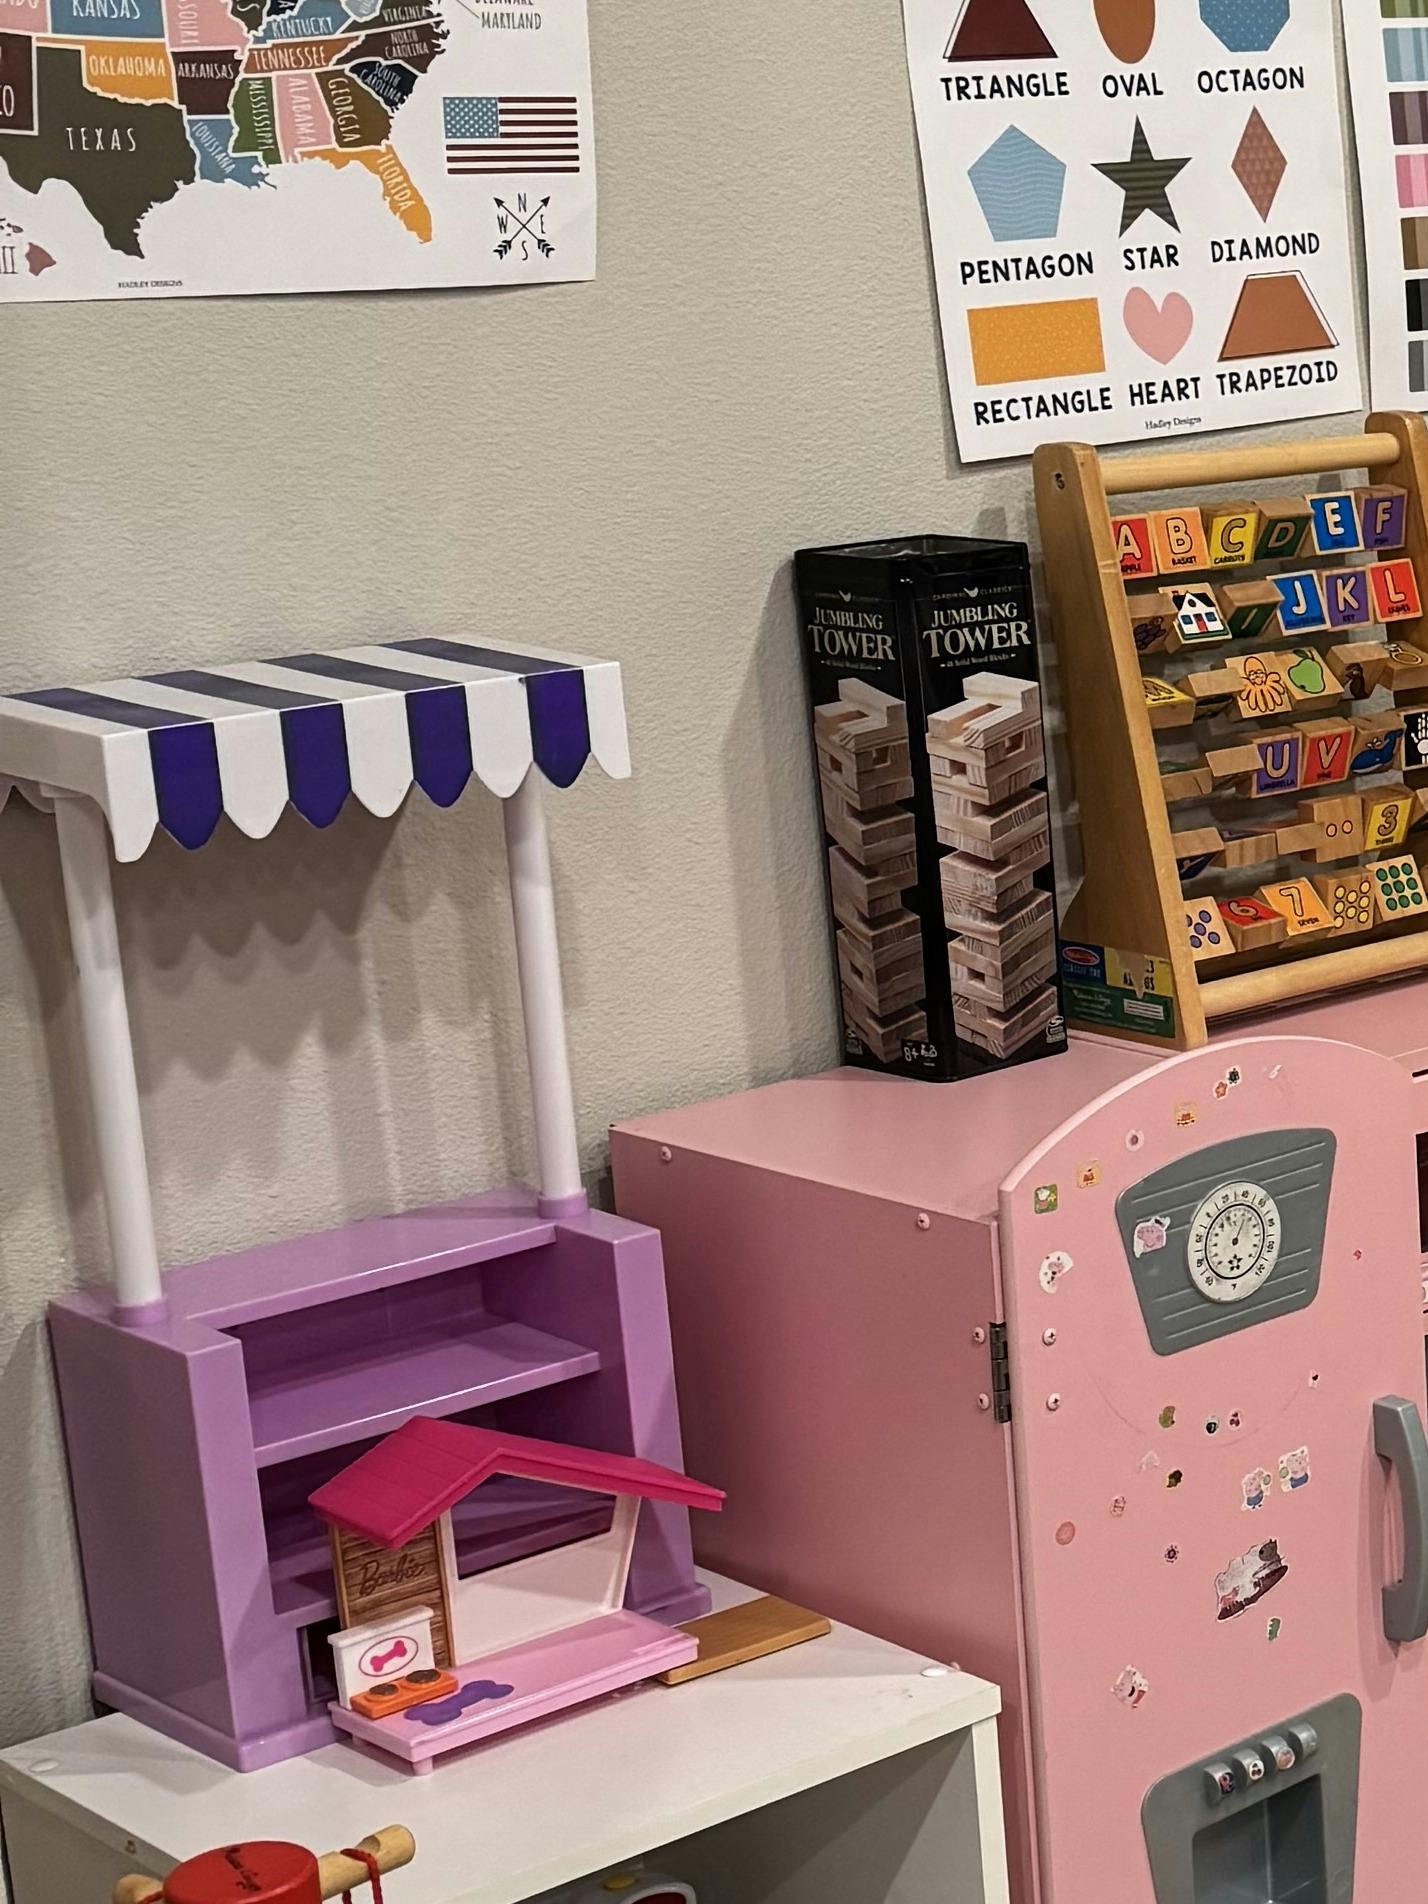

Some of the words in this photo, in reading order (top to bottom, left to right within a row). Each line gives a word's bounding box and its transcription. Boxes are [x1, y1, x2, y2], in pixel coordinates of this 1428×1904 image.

[481, 11, 541, 30] MARYLAND
[89, 53, 166, 79] OKLAHOMA
[252, 45, 328, 69] TENNESSEE
[940, 72, 1070, 101] TRIANGLE
[1102, 71, 1164, 98] OVAL
[1197, 66, 1305, 94] OCTAGON
[66, 127, 136, 152] TEXAS
[960, 251, 1094, 285] PENTAGON
[1123, 244, 1179, 271] STAR
[1211, 233, 1320, 263] DIAMOND
[974, 386, 1112, 426] RECTANGLE
[1129, 376, 1200, 407] HEART
[1216, 361, 1338, 396] TRAPEZOID
[1167, 518, 1193, 555] B
[1219, 517, 1247, 554] C
[1324, 500, 1343, 536] E
[930, 602, 1018, 629] JUMBLING
[923, 620, 1032, 659] TOWER
